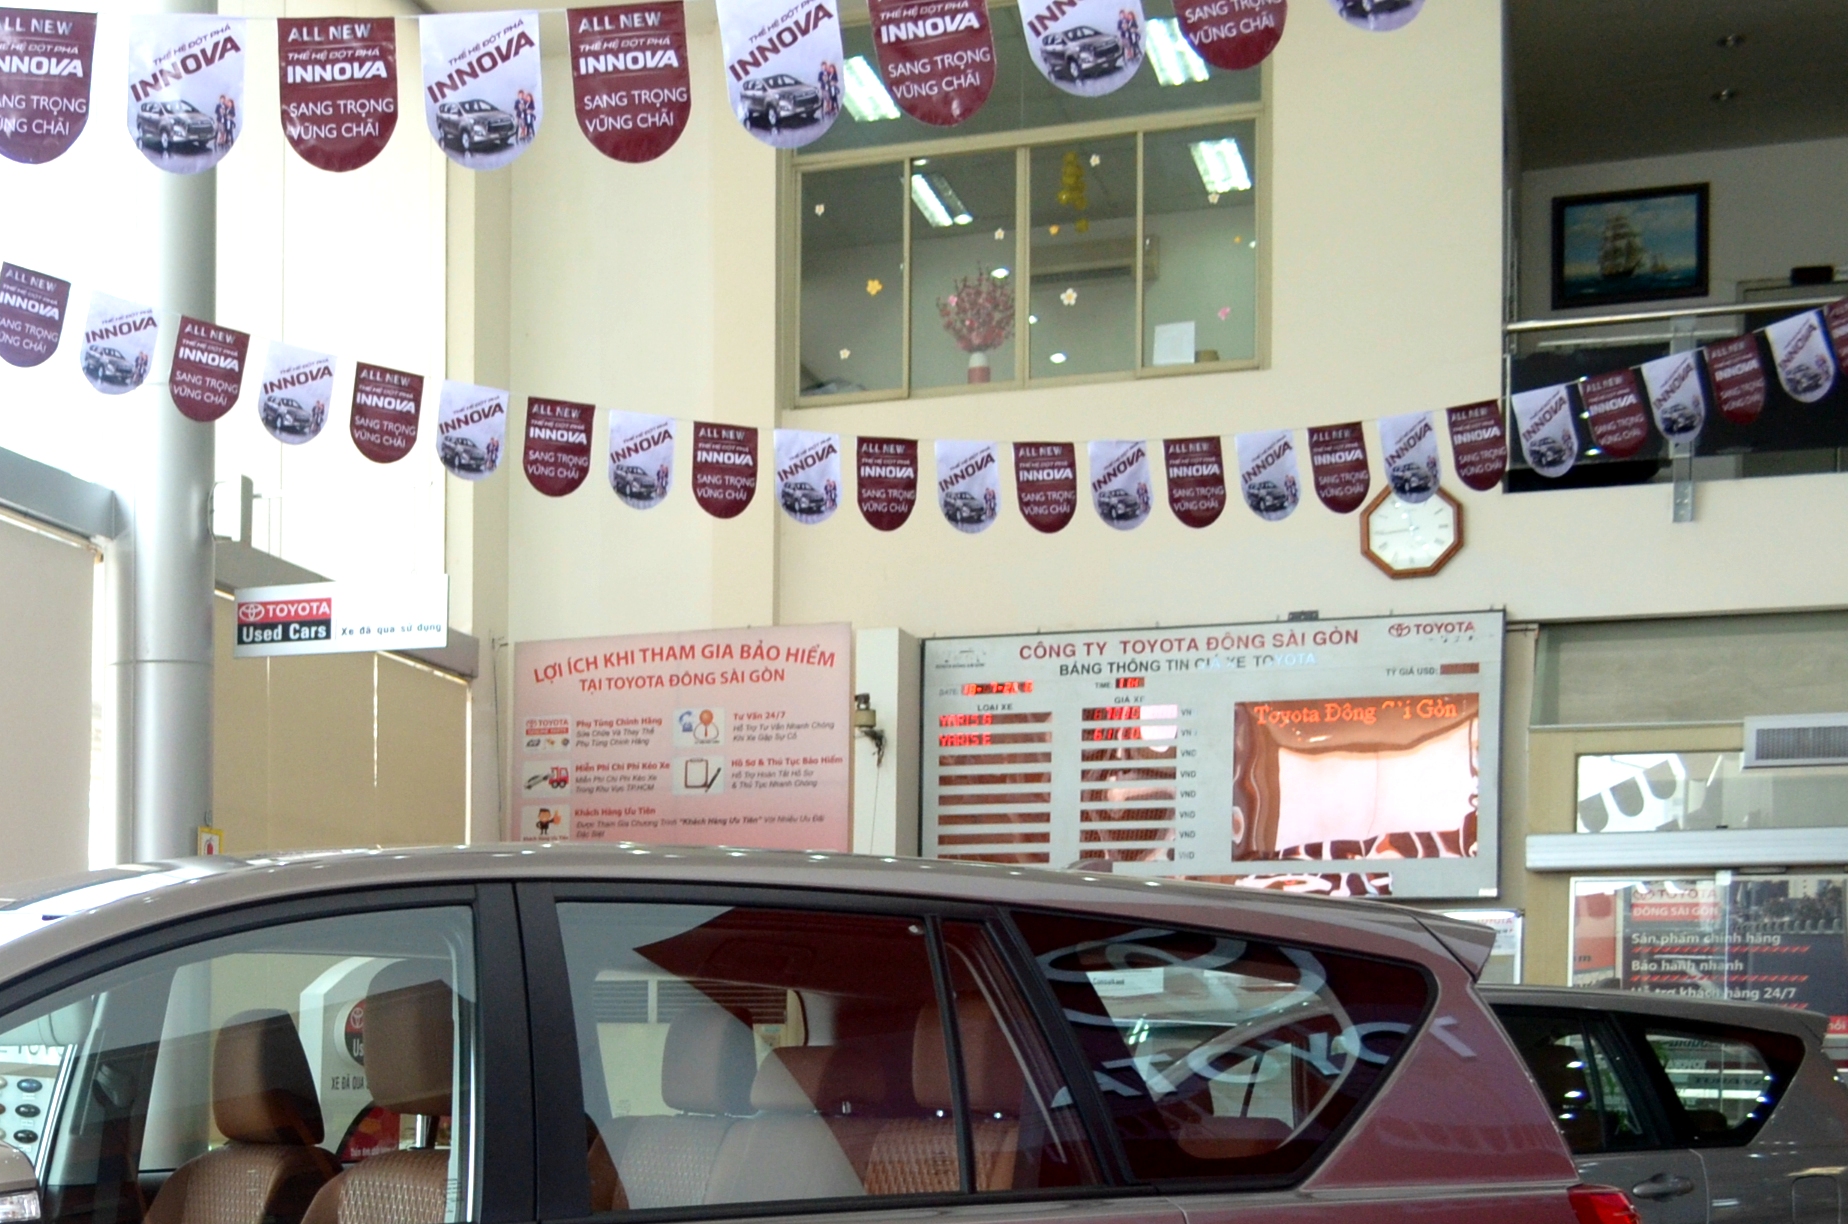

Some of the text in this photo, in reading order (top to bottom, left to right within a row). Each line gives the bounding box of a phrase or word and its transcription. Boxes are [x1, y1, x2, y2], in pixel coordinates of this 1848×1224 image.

[31, 19, 74, 35] NEW
[579, 11, 661, 33] ALL NEW
[881, 12, 980, 44] INNOVA
[288, 24, 371, 42] ALL NEW
[130, 35, 241, 102] INNOVA
[287, 61, 387, 83] INNOVA
[427, 30, 535, 103] INNOVA
[579, 50, 679, 75] INNOVA
[888, 48, 991, 78] SANG TRỌNG
[30, 94, 87, 114] TRỌNG
[290, 98, 394, 117] SANG TRỌNG
[584, 88, 687, 110] SANG TRỌNG
[637, 108, 673, 128] CHÃI
[85, 316, 158, 343] INNOVA
[264, 365, 333, 395] INNOVA
[533, 404, 581, 419] ALL NEW
[1589, 395, 1637, 416] INNOVA
[439, 402, 504, 436] INNOVA
[1453, 426, 1501, 445] INNOVA
[611, 429, 674, 464] INNOVA
[1313, 449, 1363, 466] INNOVA
[1019, 468, 1074, 482] INNOVA
[1092, 448, 1146, 492] INNOVA
[267, 602, 330, 618] TOYOTA
[242, 623, 326, 642] Used Cars
[341, 627, 354, 636] Xe
[377, 626, 395, 634] qua
[1414, 621, 1475, 636] TOYOTA
[1019, 626, 1359, 660] CÔNG TY TOYOTA ĐÔNG SÀI GÒN
[534, 640, 836, 685] LỢI ÍCH KHI THAM GIA BẢO HIỂM
[1106, 657, 1162, 675] THÔNG
[1166, 656, 1192, 672] TIN
[1253, 652, 1317, 668] TOYOTA
[580, 666, 786, 694] TẠI TOYOTA ĐÔNG SÀI GÒN
[765, 711, 786, 720] 24/7
[1254, 699, 1458, 725] Toyota Đông Gòn
[1654, 888, 1718, 899] TOYOTA
[1633, 905, 1719, 916] ĐÔNG SÀI GÒN
[1763, 987, 1796, 999] 24/7
